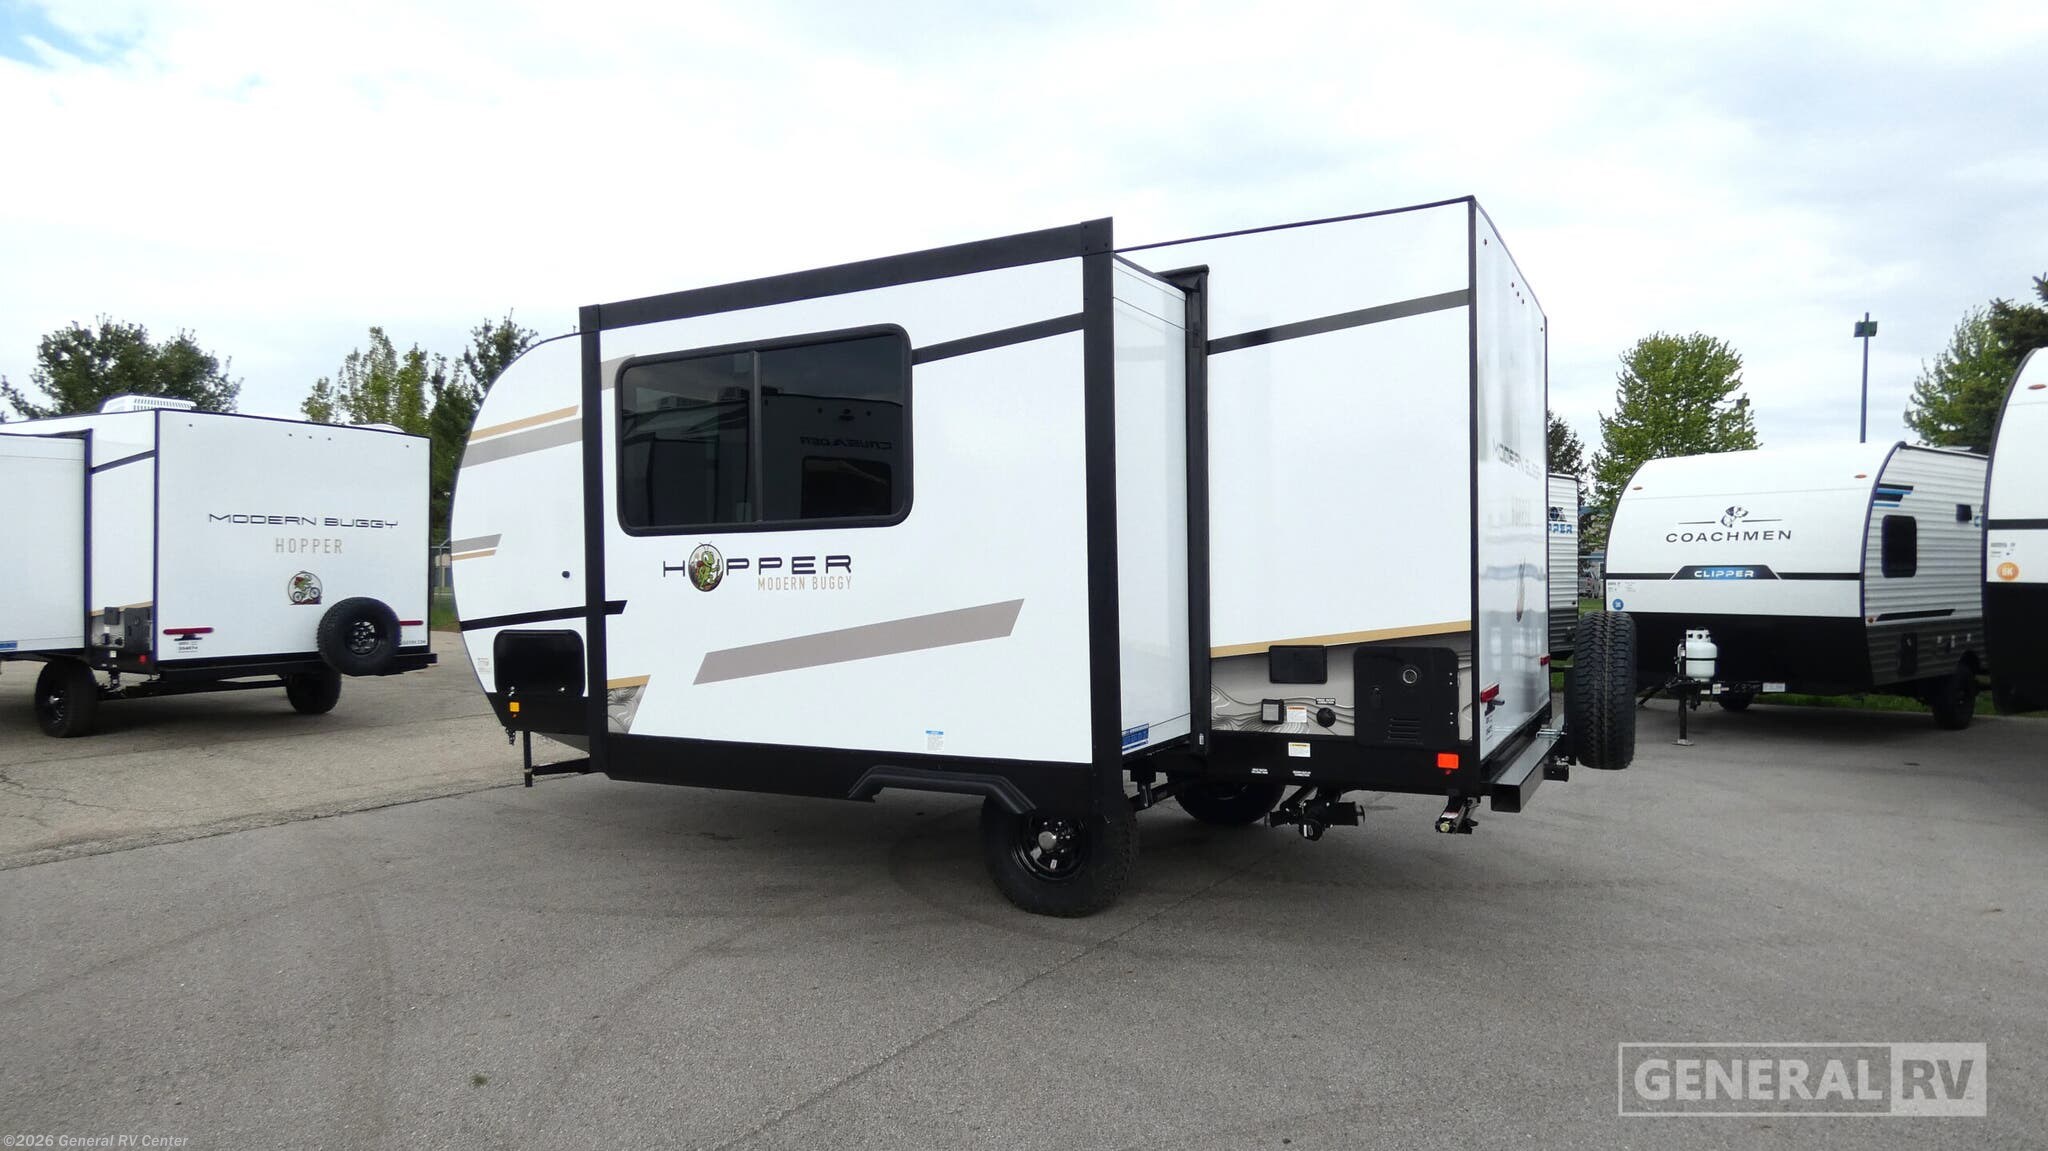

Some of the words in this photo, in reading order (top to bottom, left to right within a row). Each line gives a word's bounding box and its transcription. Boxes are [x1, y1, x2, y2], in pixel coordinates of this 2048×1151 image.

[209, 513, 317, 526] MODERN
[324, 517, 398, 528] BUGGY
[1549, 524, 1573, 534] PPER
[1666, 530, 1791, 543] COACHMEN
[275, 538, 342, 554] HOPPER
[1694, 570, 1755, 578] CLIPPER
[758, 577, 806, 591] MODERN
[812, 576, 851, 590] BUGGY
